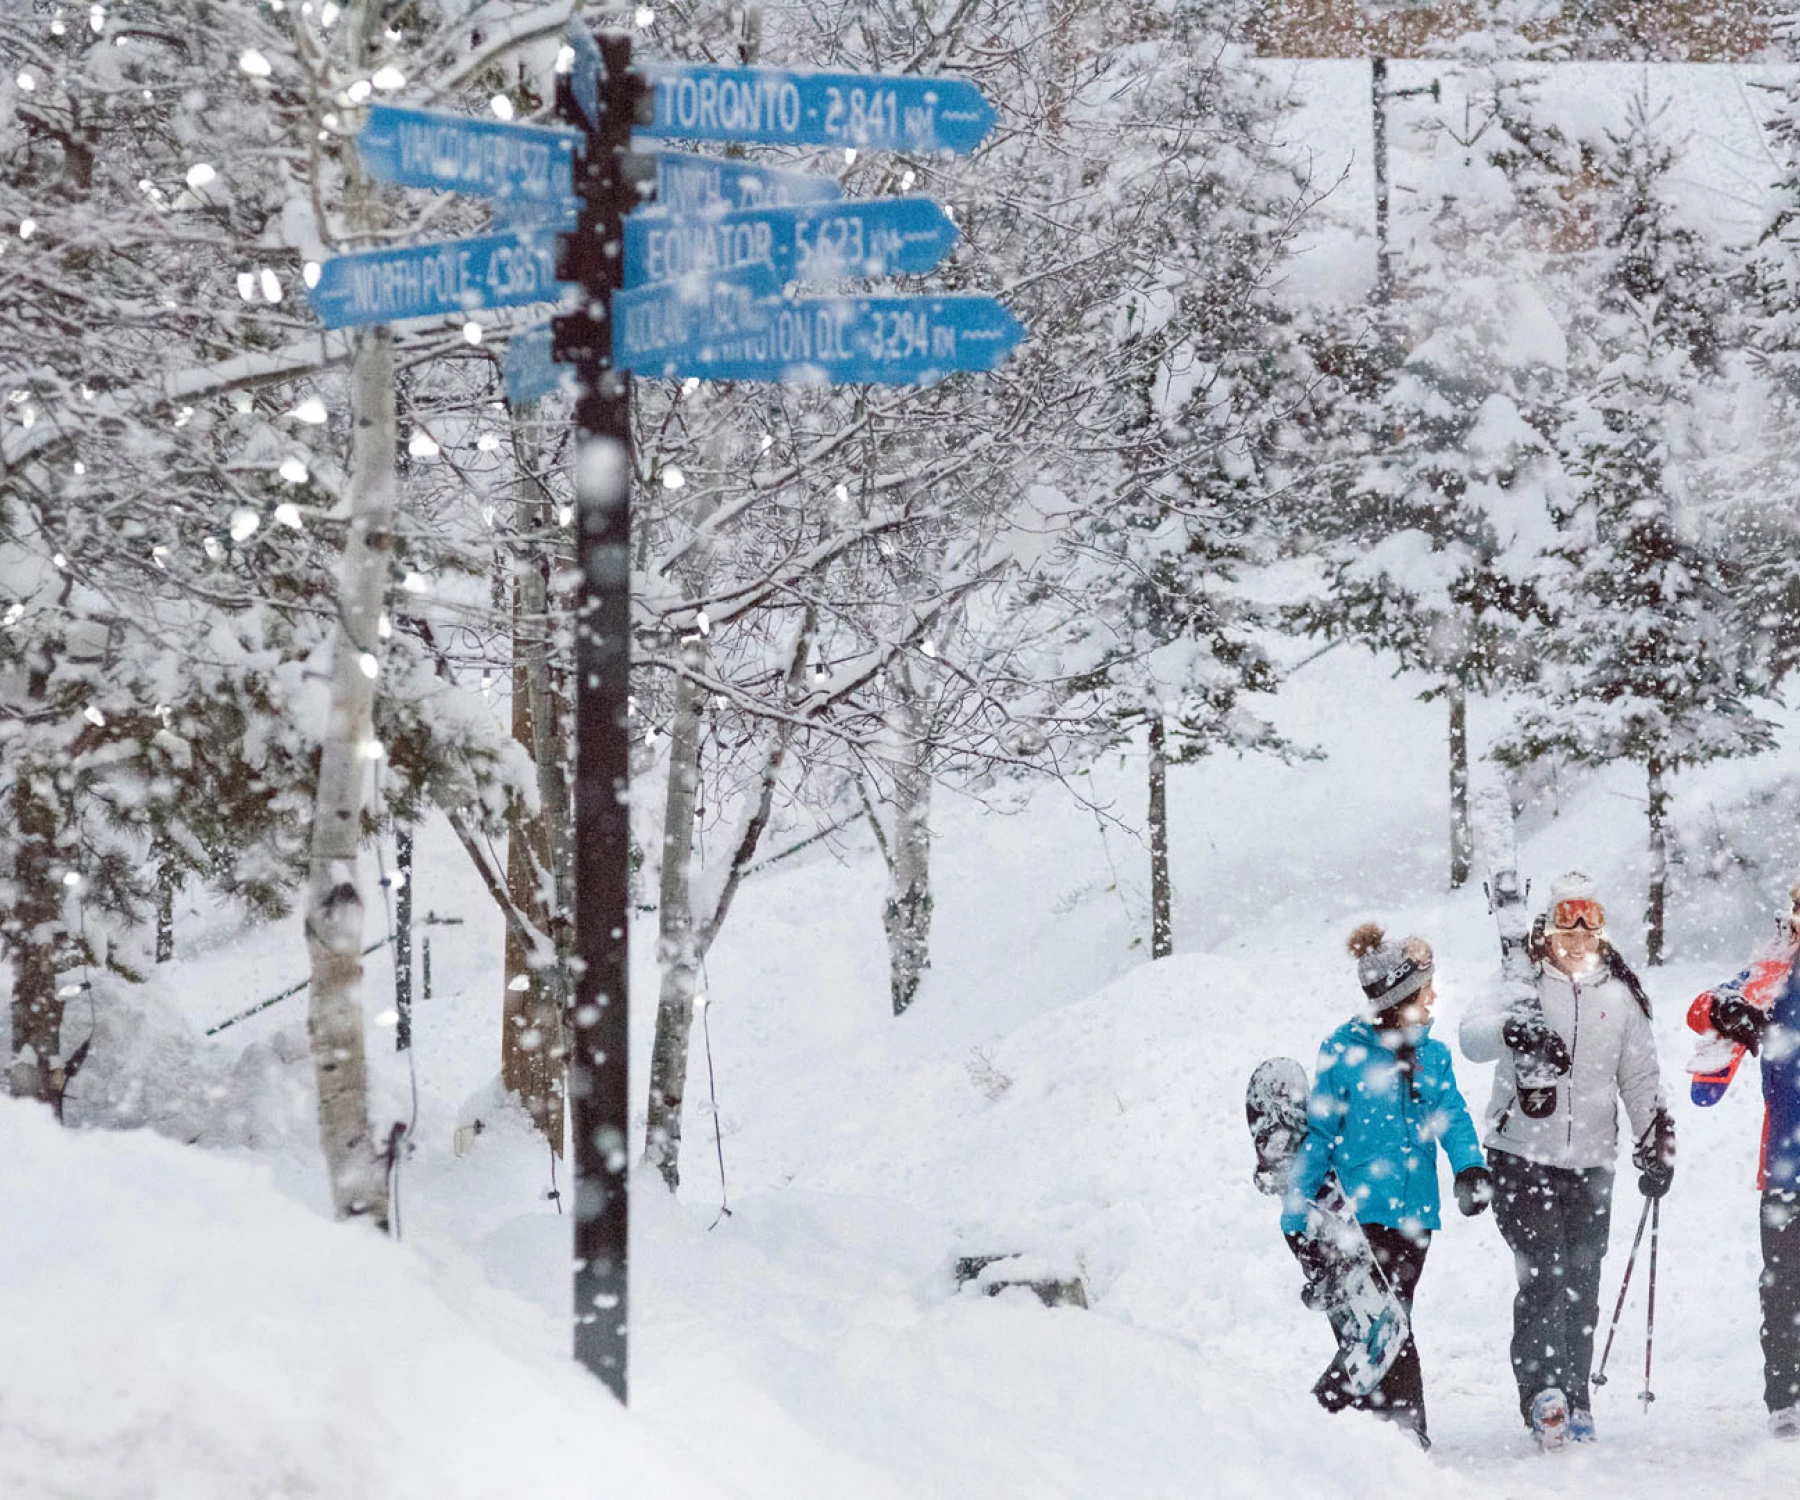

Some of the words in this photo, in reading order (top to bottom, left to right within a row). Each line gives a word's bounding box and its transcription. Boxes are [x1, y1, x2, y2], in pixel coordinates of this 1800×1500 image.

[661, 77, 800, 133] TORONTO
[824, 86, 897, 139] 2,841
[648, 221, 773, 278] EQUATOR
[353, 258, 420, 312] NORTH
[423, 251, 471, 303] POLE
